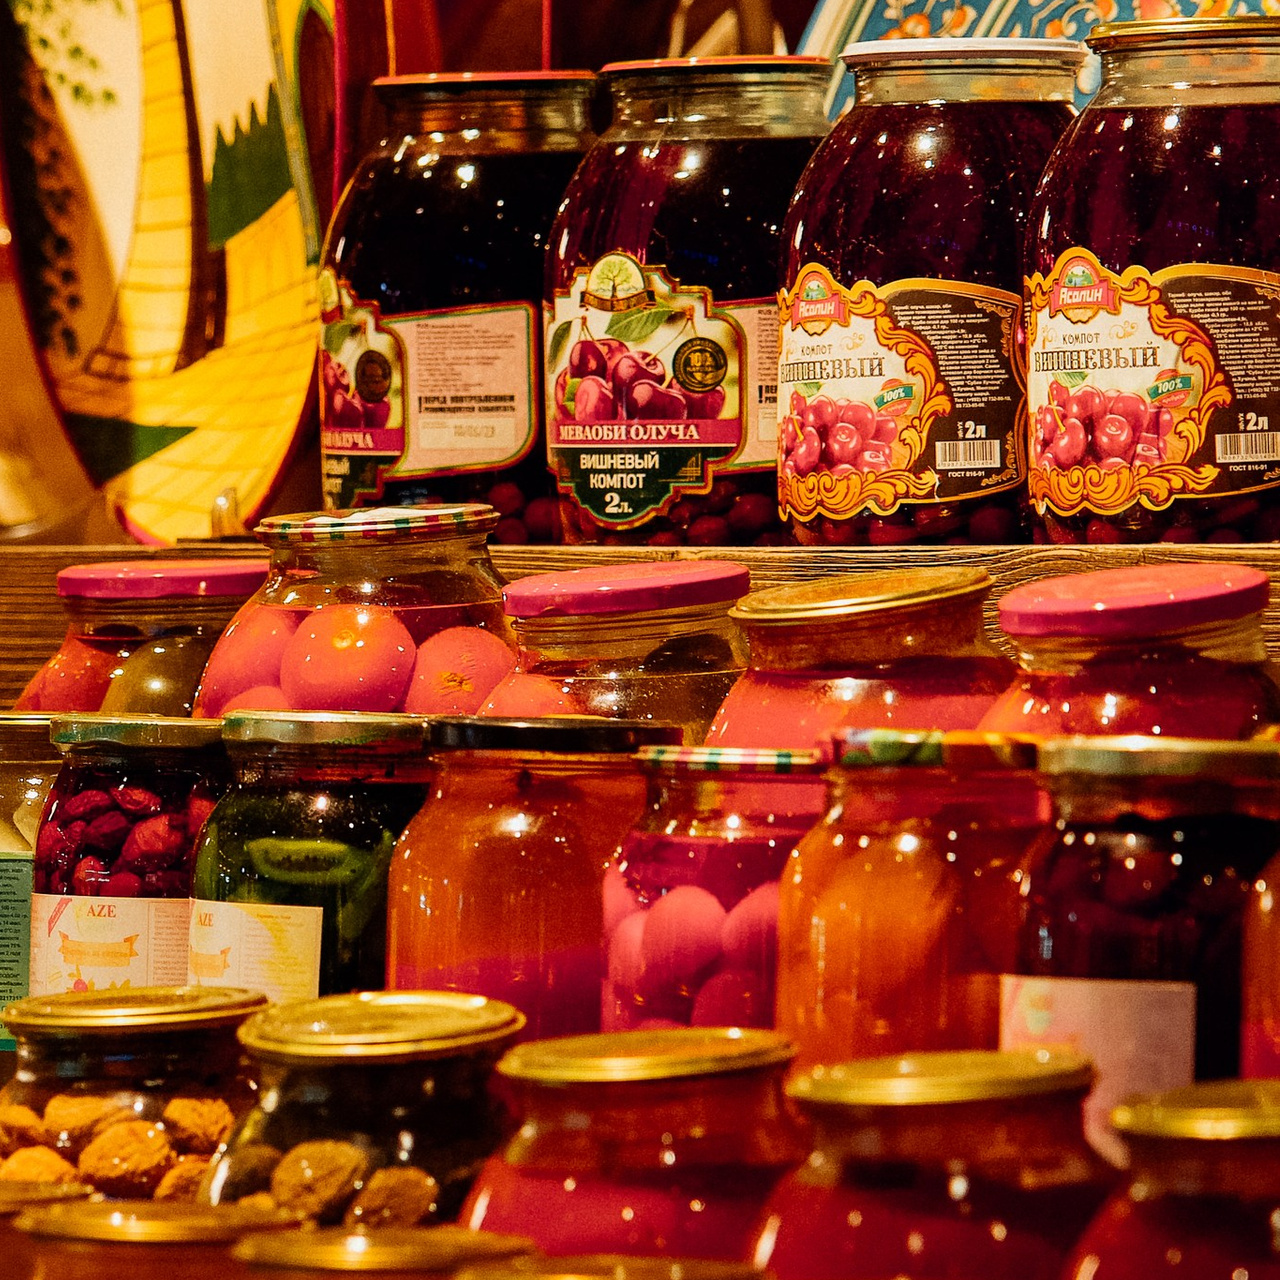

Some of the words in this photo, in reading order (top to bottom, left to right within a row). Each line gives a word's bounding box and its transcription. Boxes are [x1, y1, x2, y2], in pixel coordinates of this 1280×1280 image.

[1059, 287, 1103, 305] Асалин
[799, 301, 835, 318] Асалин
[1062, 332, 1101, 346] КОМПОТ
[801, 344, 833, 357] КОМПОТ
[1158, 378, 1183, 394] 100%
[883, 388, 906, 403] 100%
[964, 420, 987, 439] 2л
[1246, 412, 1269, 431] 2л
[559, 425, 627, 441] МЕВАОБИ
[630, 424, 700, 440] ОЛУЧА
[580, 451, 660, 469] ВИШНЕВЫЙ
[589, 473, 646, 489] КОМПОТ
[604, 492, 633, 513] 2л.
[86, 904, 117, 918] AZE
